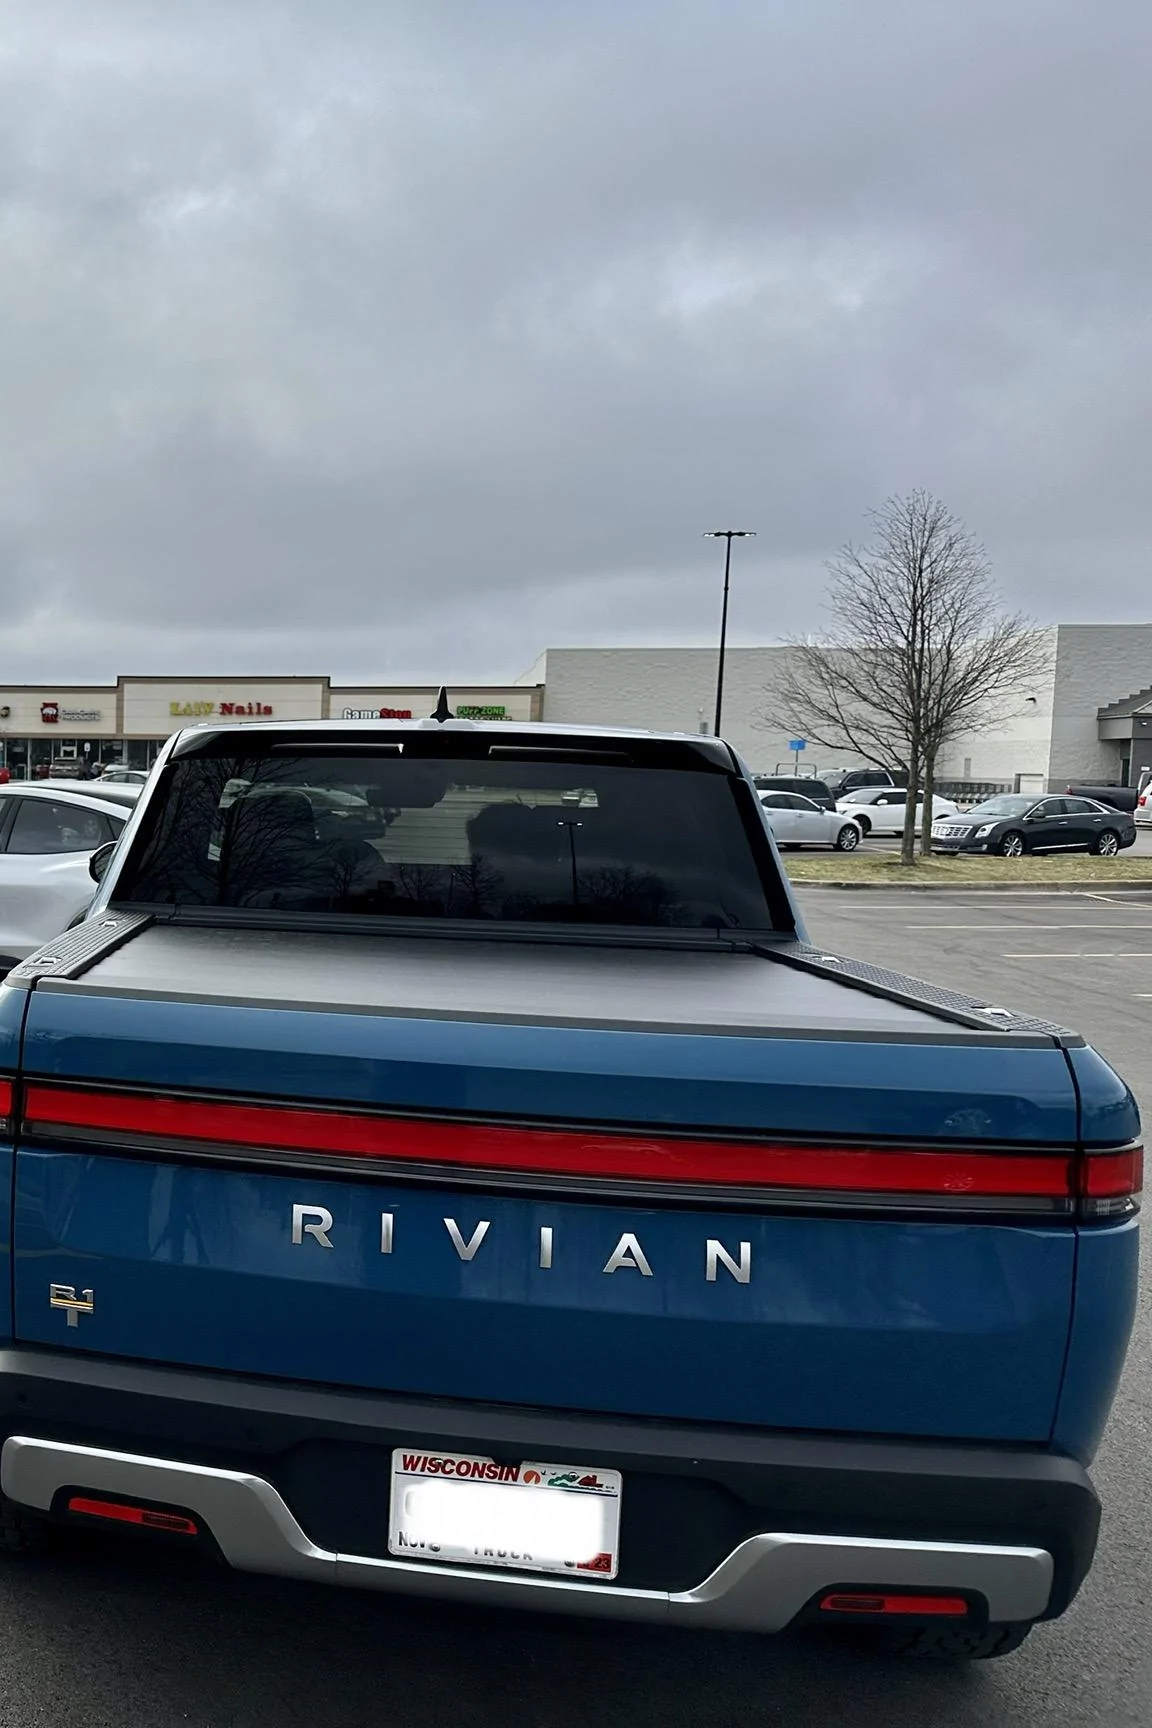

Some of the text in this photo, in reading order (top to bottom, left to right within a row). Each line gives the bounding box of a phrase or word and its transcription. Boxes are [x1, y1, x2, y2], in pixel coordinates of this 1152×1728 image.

[220, 702, 273, 715] Nails
[481, 706, 505, 715] ZONE
[292, 1204, 751, 1283] RIVIAN
[403, 1455, 521, 1482] WISCONSIN
